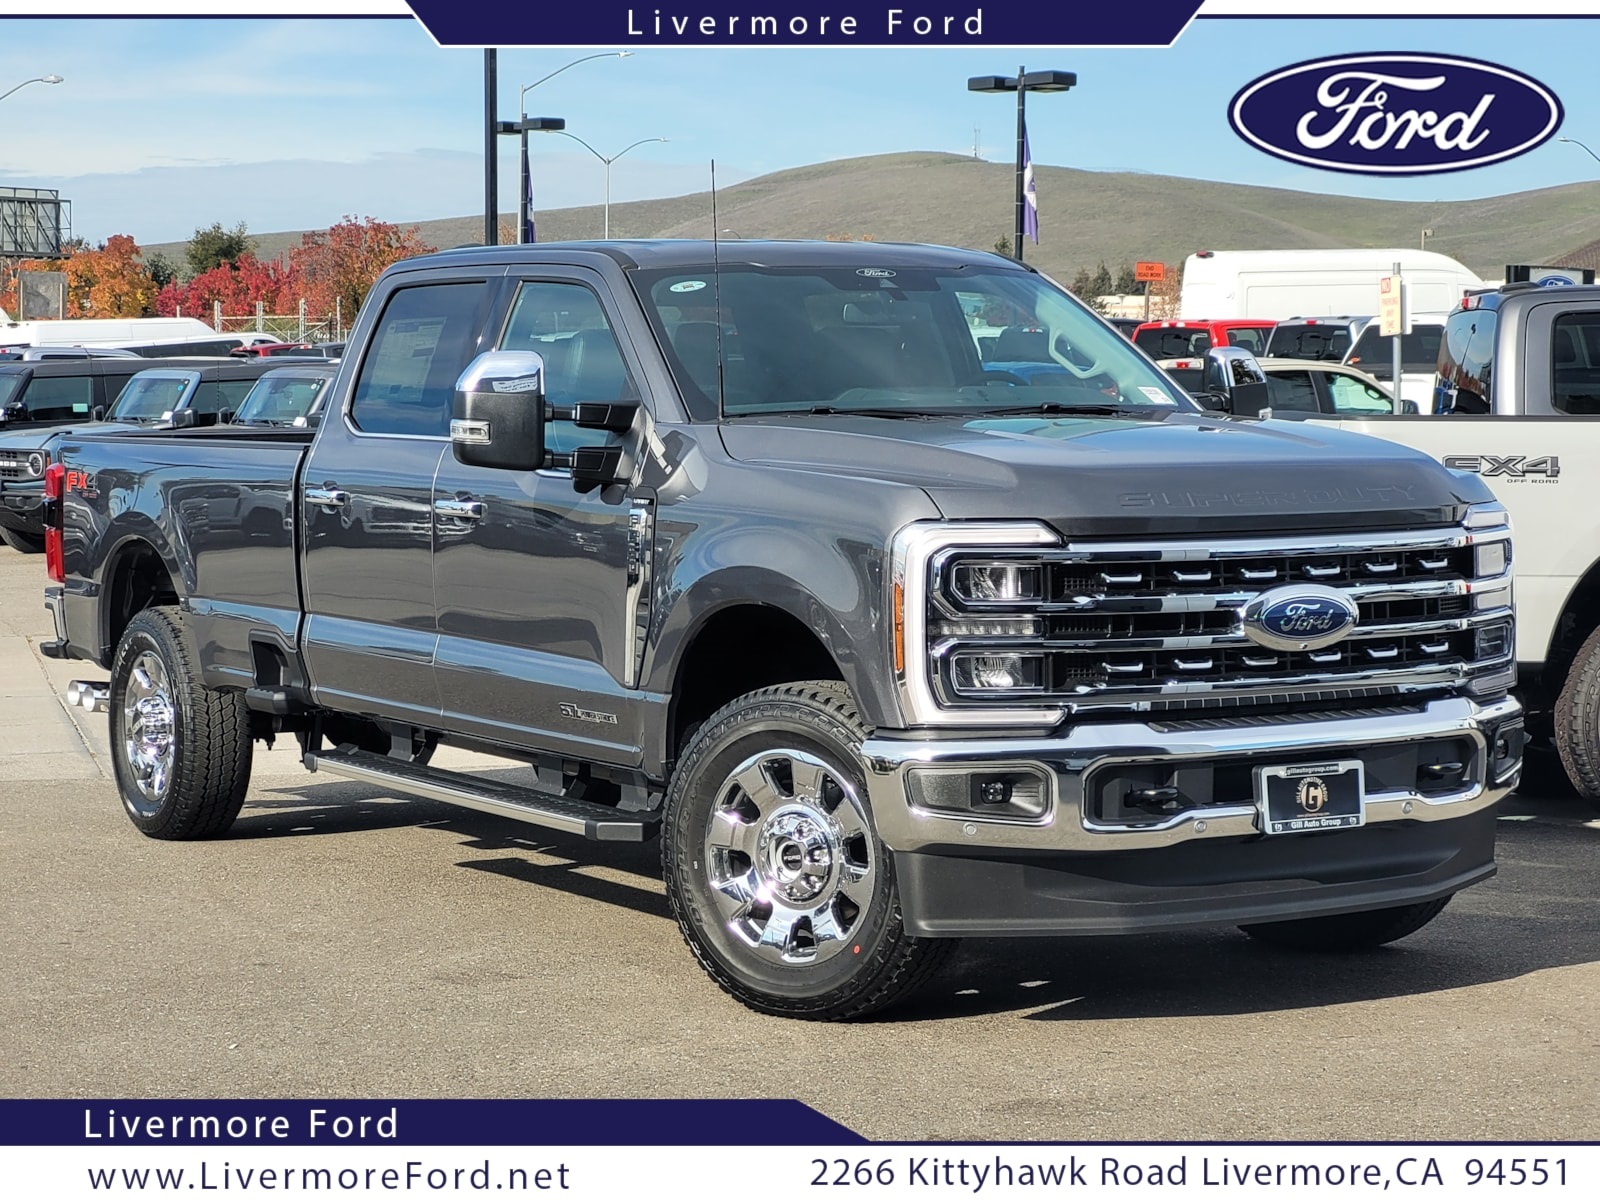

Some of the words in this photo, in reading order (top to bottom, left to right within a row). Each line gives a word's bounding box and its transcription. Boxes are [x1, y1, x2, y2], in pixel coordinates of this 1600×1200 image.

[66, 471, 98, 493] FX4
[1280, 603, 1334, 632] Ford
[1291, 820, 1303, 829] Gill
[1304, 820, 1319, 828] Auto
[1321, 819, 1341, 827] Group
